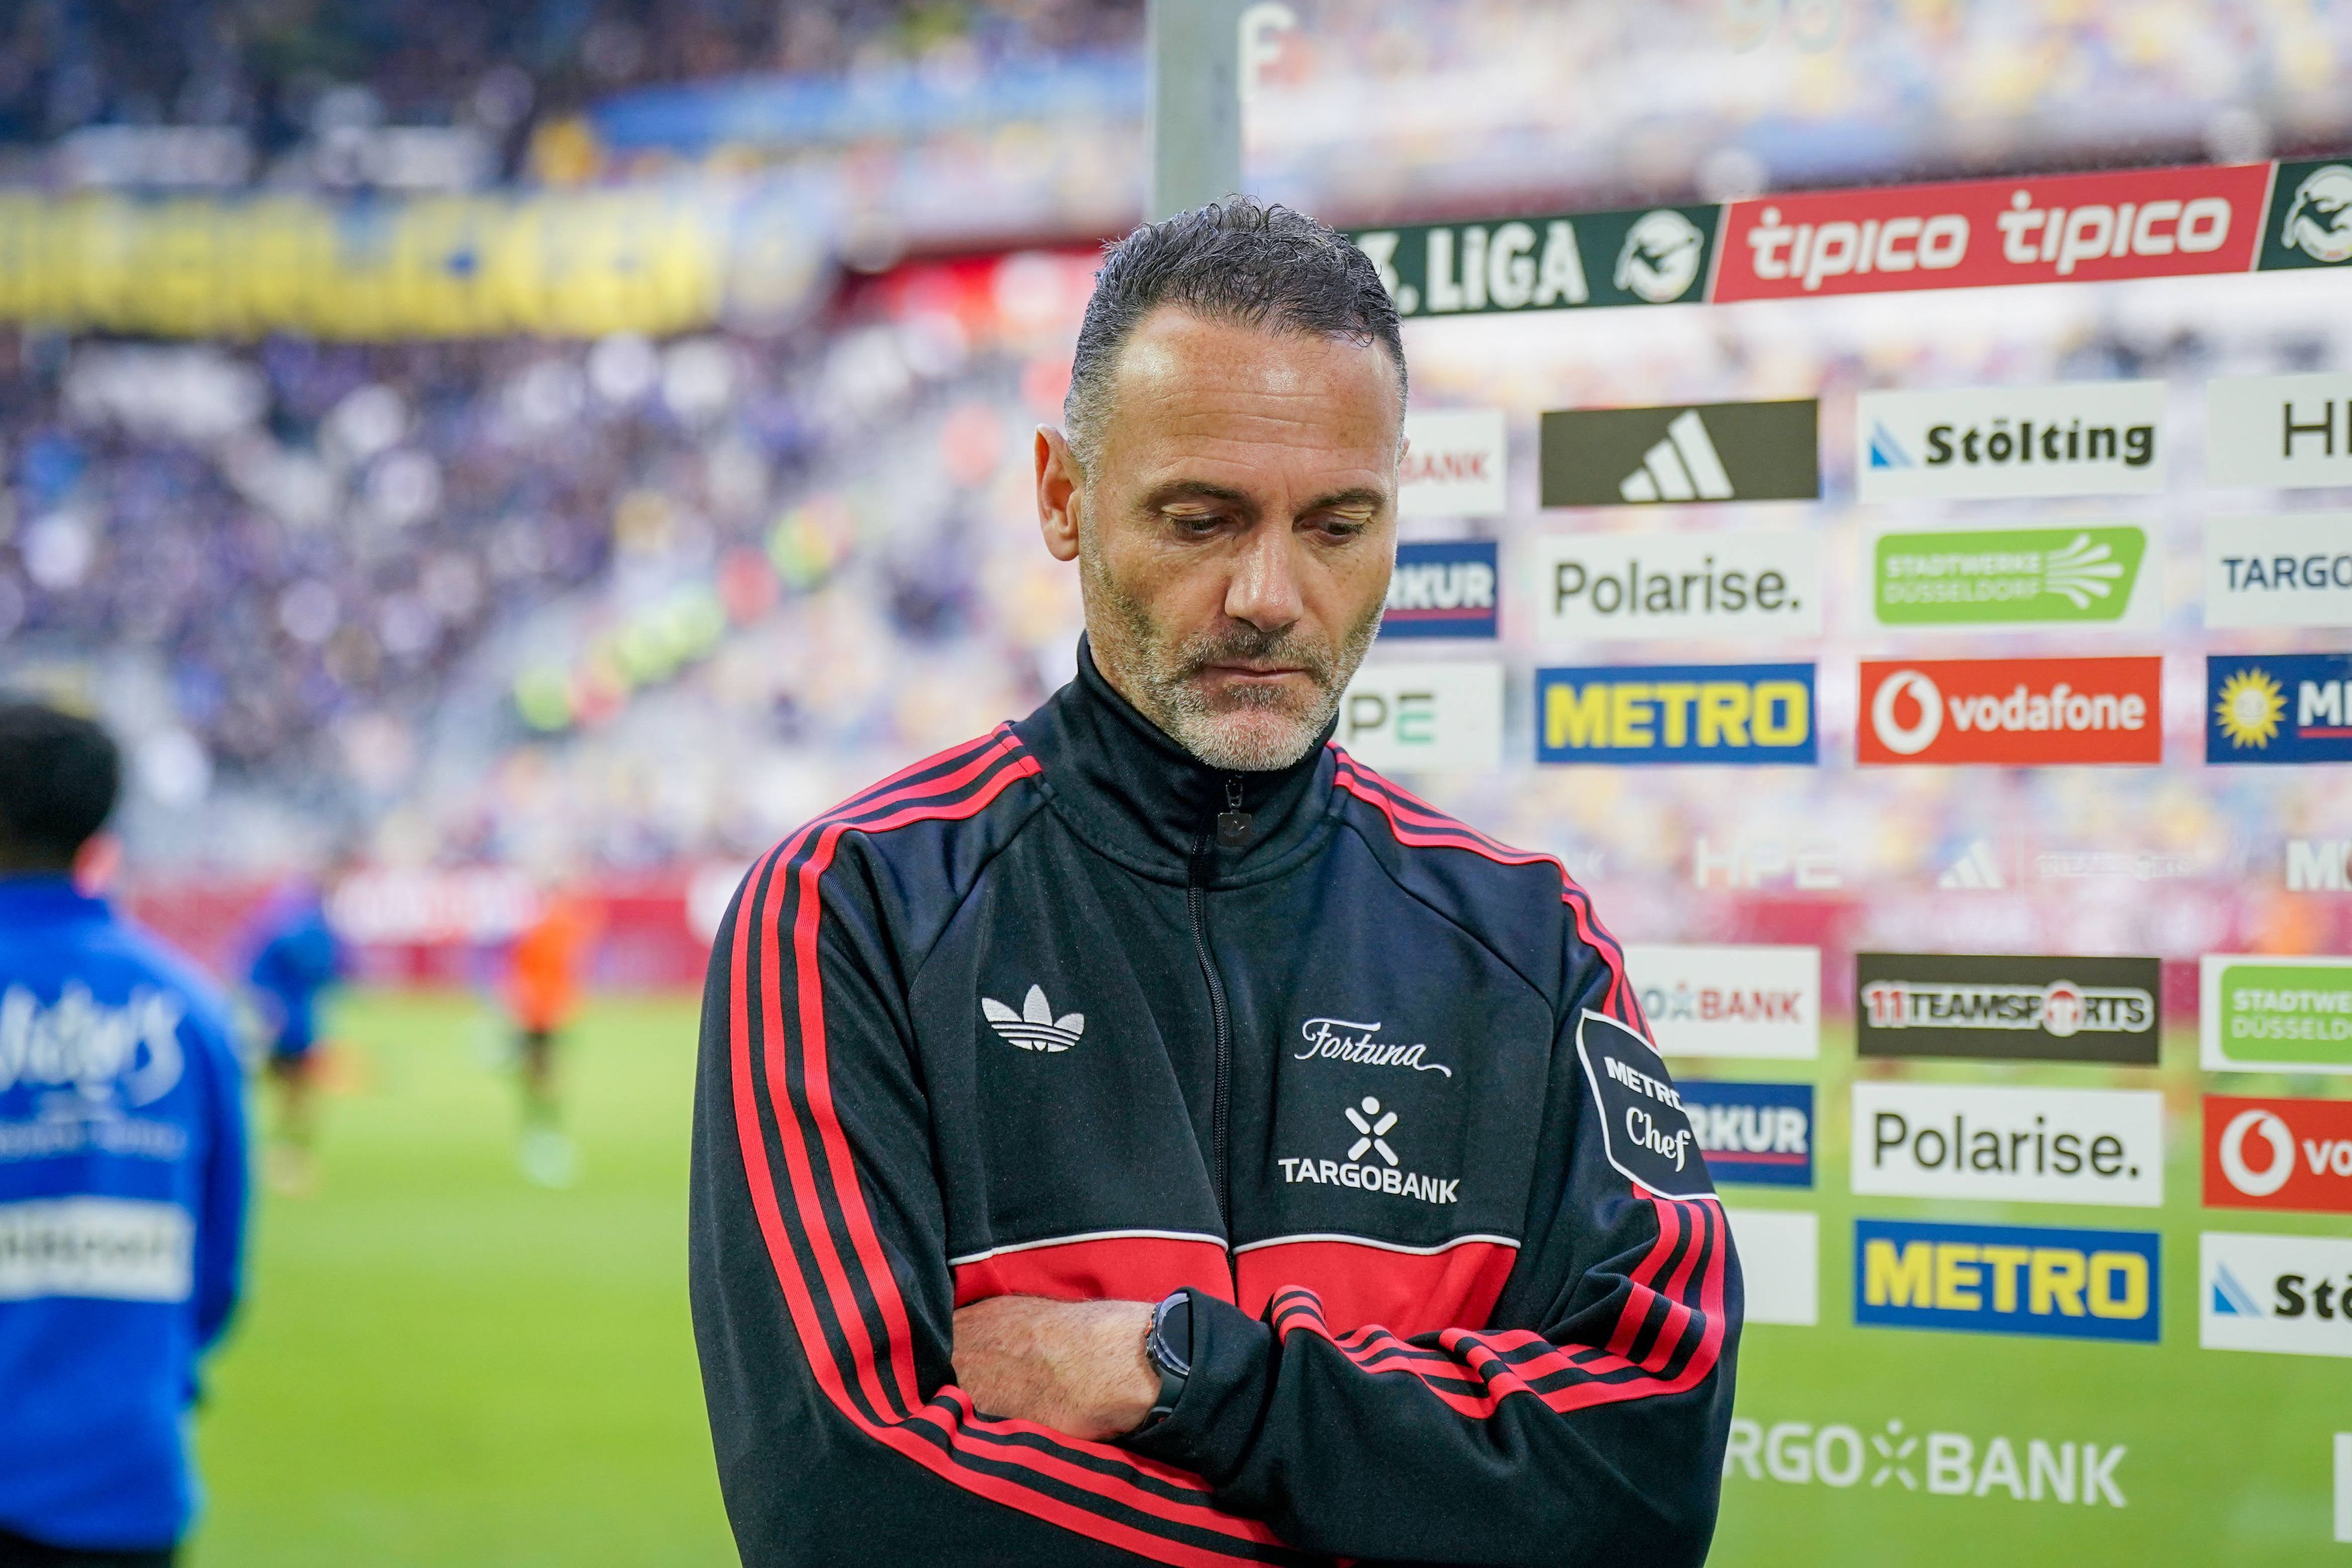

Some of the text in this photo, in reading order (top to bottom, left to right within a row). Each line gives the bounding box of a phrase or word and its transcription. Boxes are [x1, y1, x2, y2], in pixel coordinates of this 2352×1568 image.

[1747, 206, 1970, 292] tipico
[1997, 189, 2232, 276] tipico
[1925, 418, 2156, 467] Stölting
[2284, 399, 2352, 457] H
[1554, 557, 1802, 616] Polarise.
[1886, 551, 2040, 579] STADTWERKE
[1347, 691, 1435, 744] PE
[1545, 680, 1808, 748] METRO
[1948, 683, 2146, 732] vodafone
[1294, 1018, 1452, 1078] Fortuna
[2231, 1014, 2352, 1041] DÜSSELD
[1626, 1106, 1691, 1172] Chef
[1683, 1103, 1809, 1154] RKUR
[1874, 1112, 2140, 1178] Polarise.
[1278, 1158, 1460, 1204] TARGOBANK
[1865, 1239, 2149, 1320] METRO
